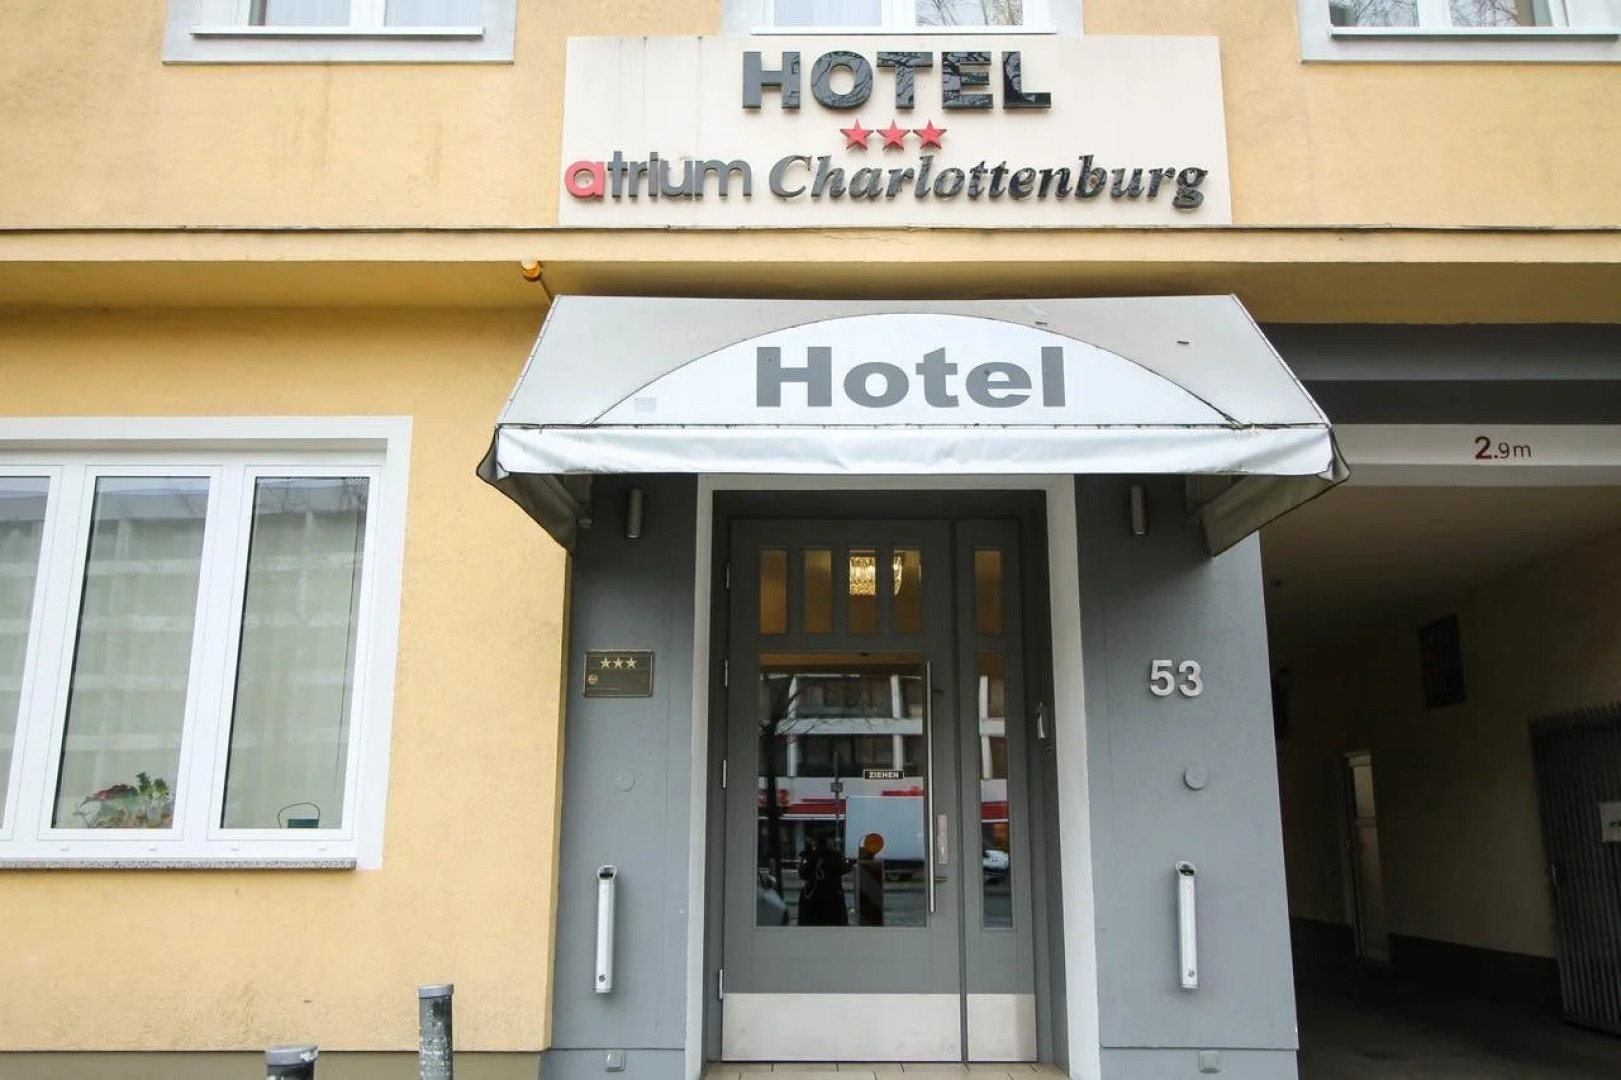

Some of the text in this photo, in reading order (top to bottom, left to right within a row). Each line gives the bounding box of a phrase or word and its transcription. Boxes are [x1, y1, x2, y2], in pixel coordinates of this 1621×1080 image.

[742, 51, 1051, 109] HOTEL
[565, 151, 1208, 209] atrium Charlottenburg
[756, 346, 1066, 408] Hotel
[1475, 436, 1531, 459] 2.9m
[1150, 660, 1203, 697] 53
[869, 771, 899, 779] ZIEHEN
